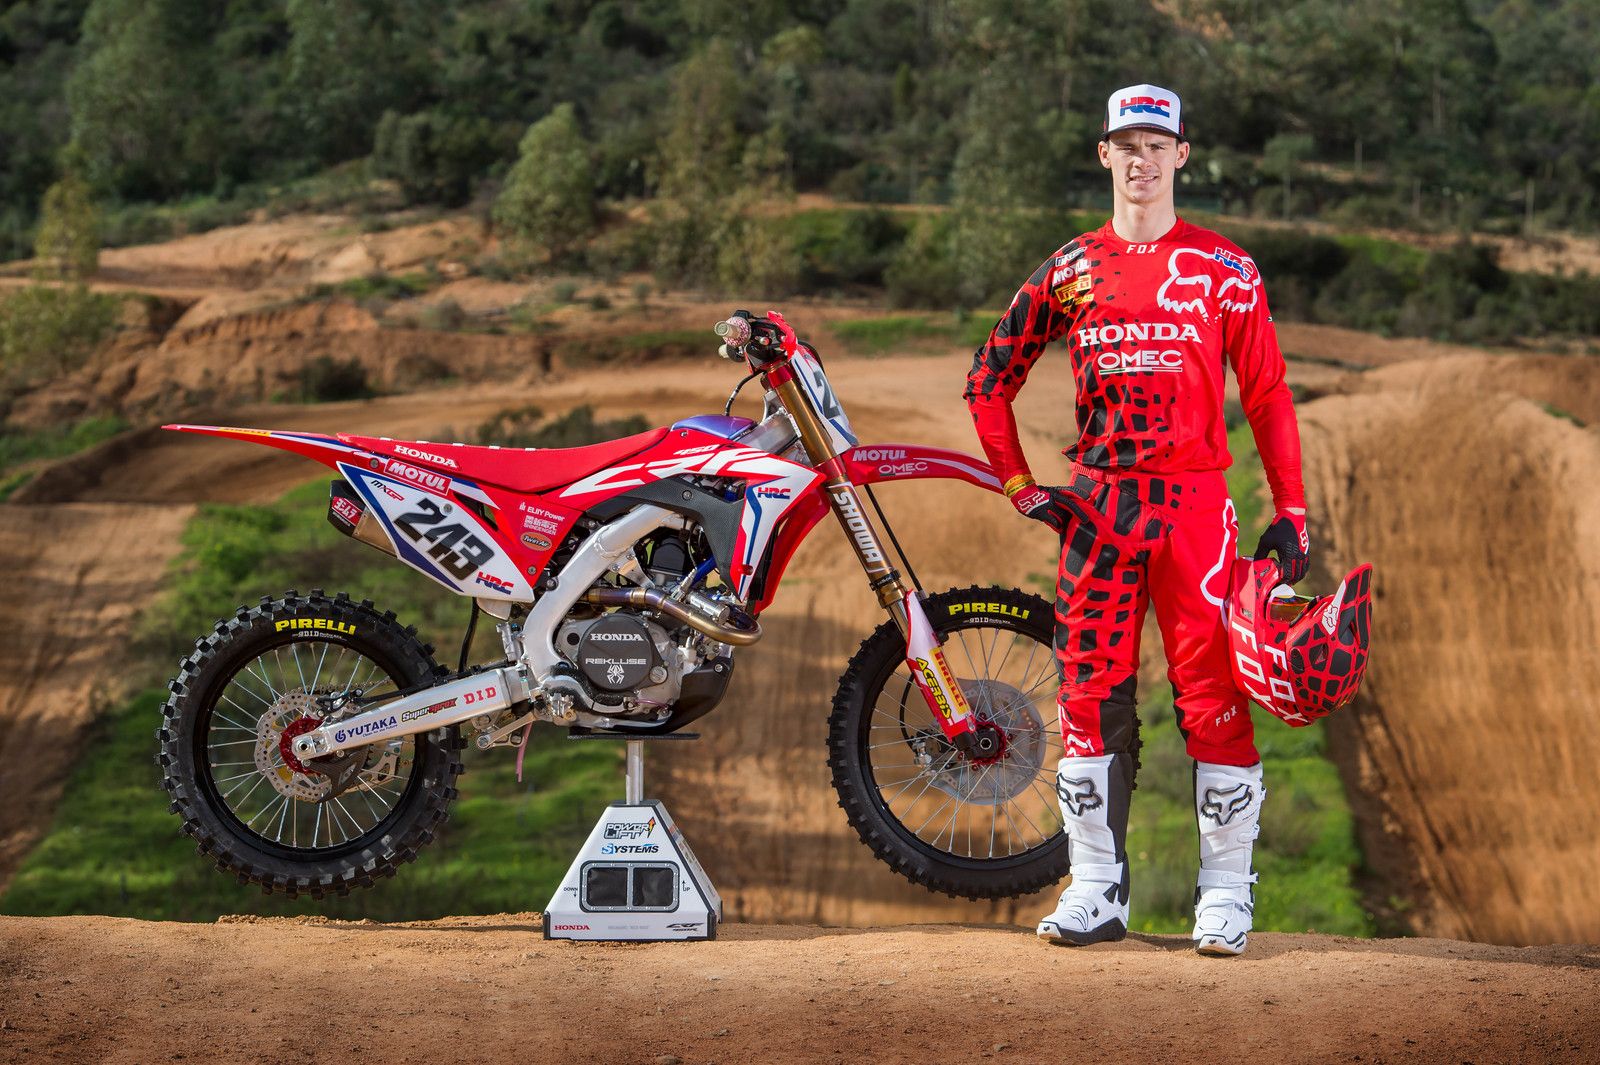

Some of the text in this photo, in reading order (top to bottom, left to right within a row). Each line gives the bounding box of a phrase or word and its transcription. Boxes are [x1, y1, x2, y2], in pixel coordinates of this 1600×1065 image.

[1120, 96, 1170, 118] HRC
[1126, 244, 1159, 254] FOX
[1214, 247, 1254, 281] HRC
[1077, 323, 1202, 347] HONDA
[1097, 350, 1183, 369] OMEC
[394, 445, 458, 468] HONDA
[852, 450, 907, 461] MOTUL
[388, 462, 446, 492] MOTUL
[878, 462, 928, 475] OMEC
[758, 487, 791, 499] HRC
[834, 491, 883, 563] SHOWA
[394, 497, 495, 581] 243
[476, 571, 514, 595] HRC
[949, 602, 1030, 620] PIRELLI
[275, 618, 357, 635] PIRELLI
[590, 633, 644, 641] HONDA
[1231, 621, 1277, 713] FOX
[1264, 644, 1309, 724] FOX
[347, 716, 397, 738] YUTAKA
[1215, 706, 1237, 727] FOX
[601, 843, 660, 855] SYSTEMS
